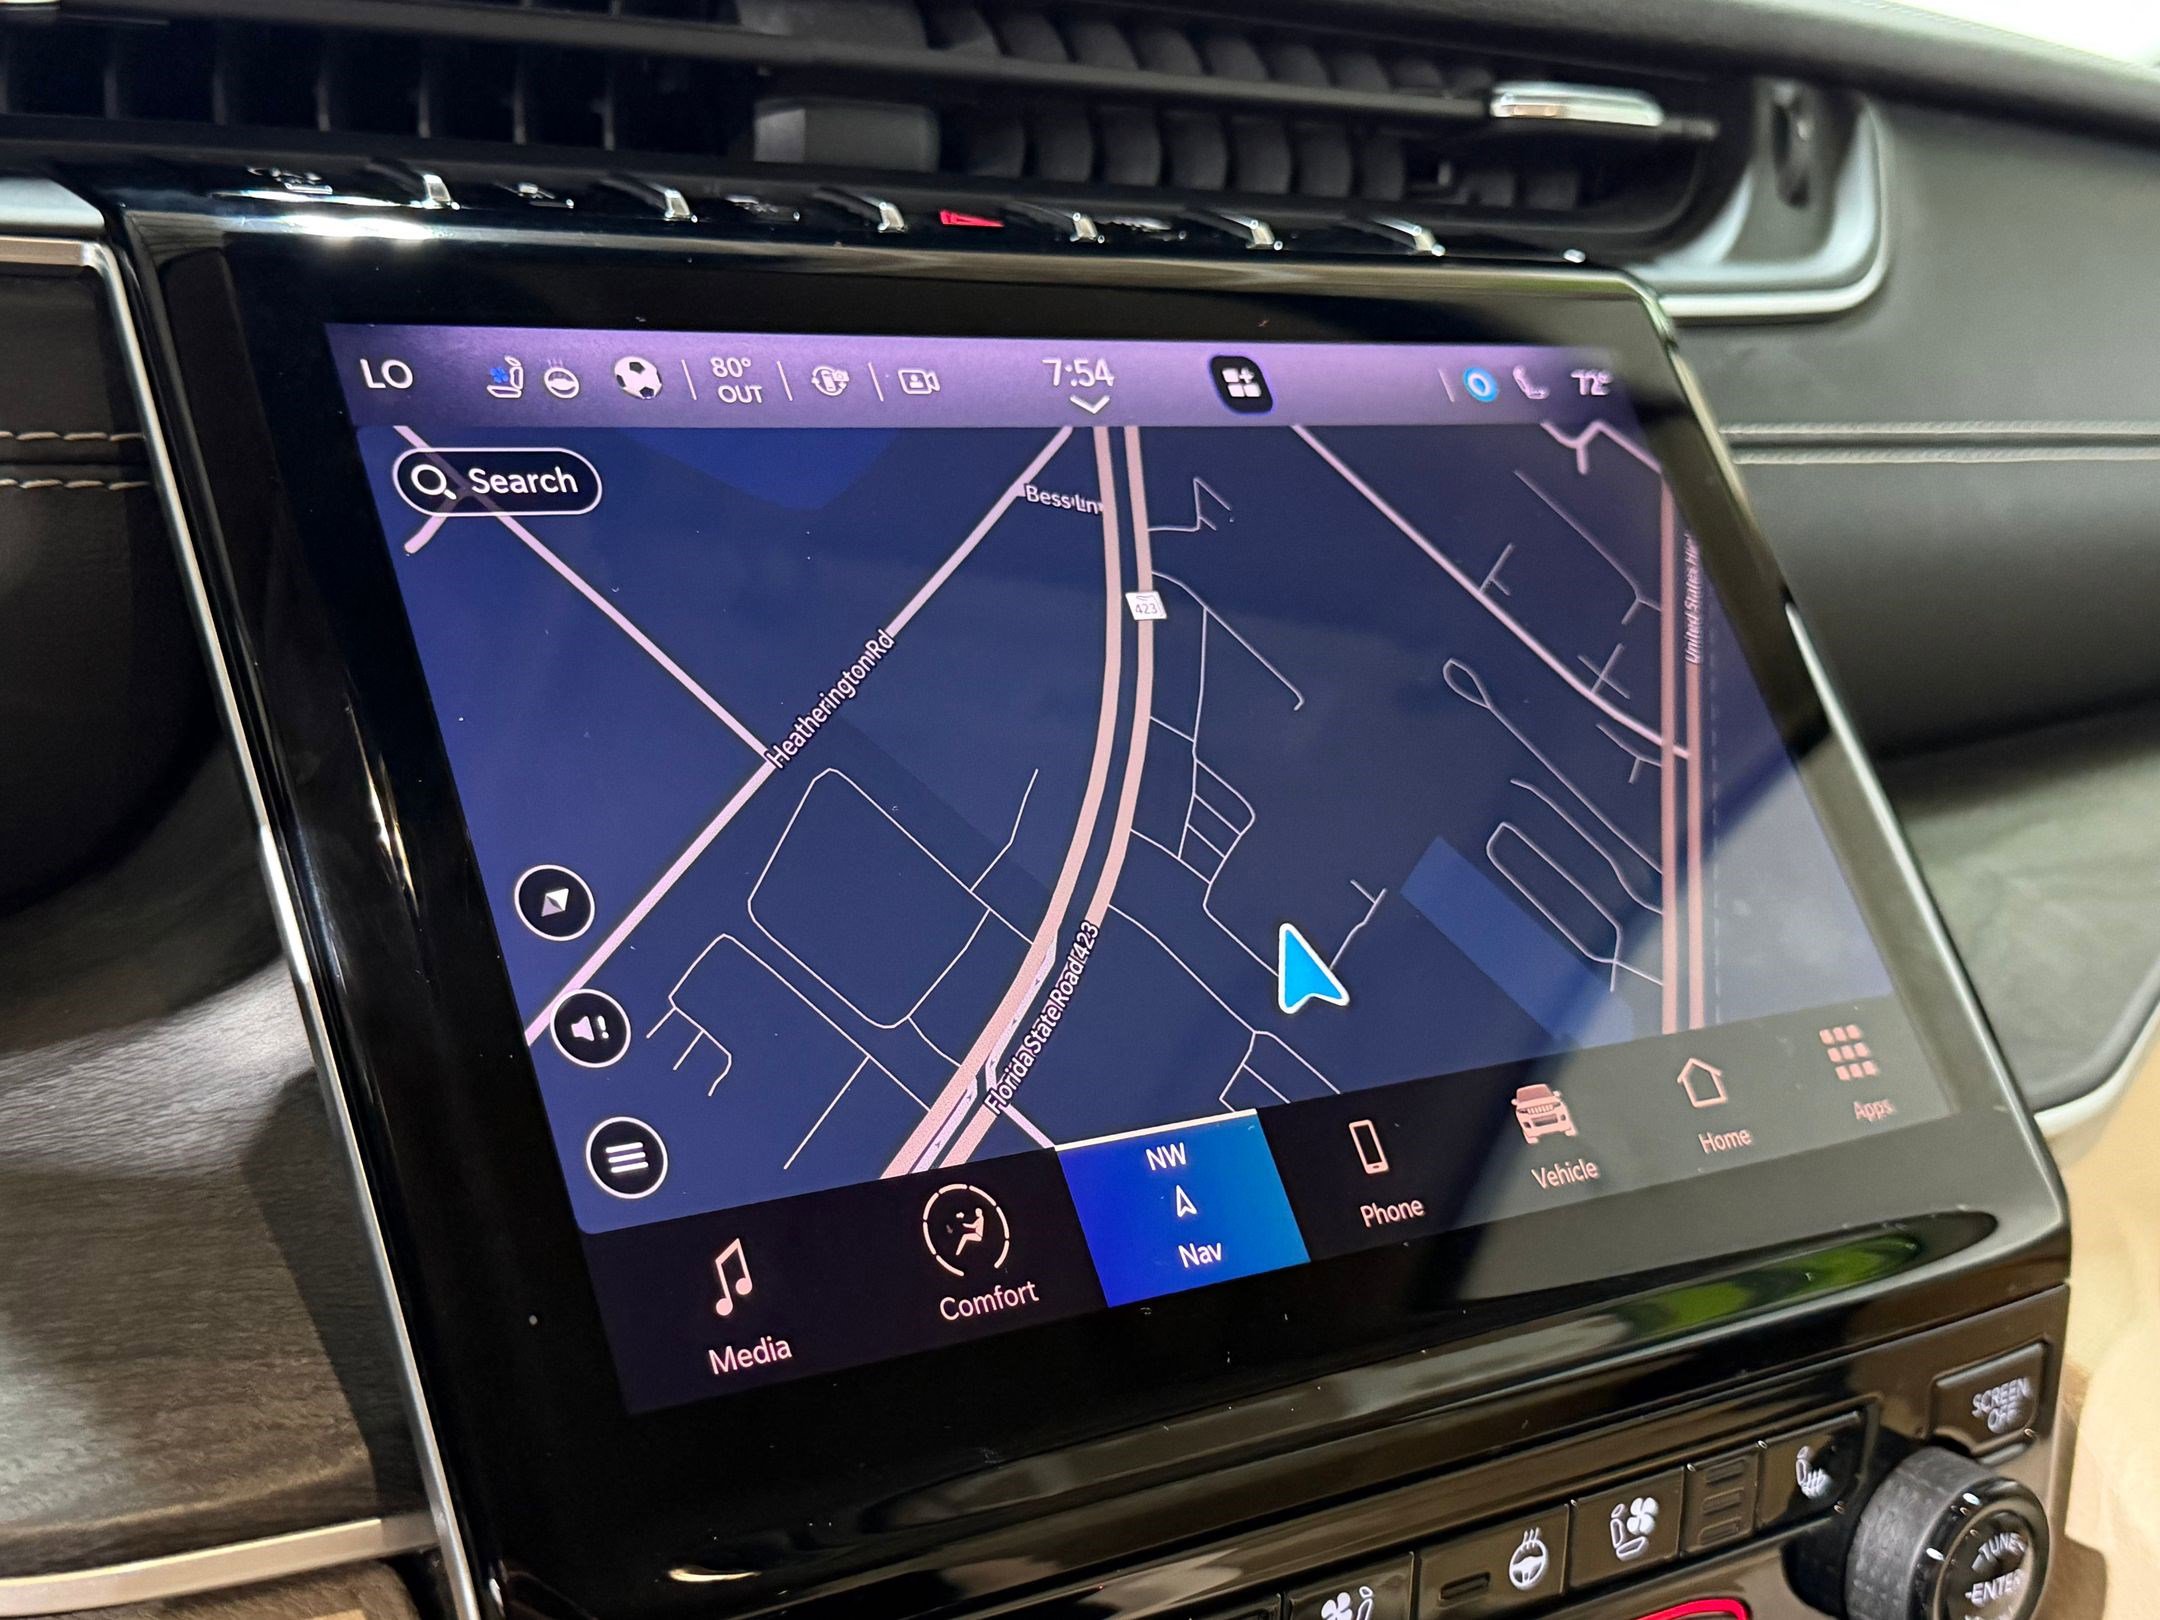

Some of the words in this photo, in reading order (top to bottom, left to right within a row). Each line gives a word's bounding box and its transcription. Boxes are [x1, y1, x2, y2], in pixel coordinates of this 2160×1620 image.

[360, 358, 413, 391] LO
[710, 357, 752, 379] 80°
[1042, 358, 1114, 387] 7:54
[717, 383, 763, 405] OUT
[467, 466, 580, 496] Search
[1025, 484, 1071, 509] Bess
[1135, 602, 1159, 615] 423
[1684, 611, 1702, 664] United
[766, 653, 876, 769] Heatherington
[864, 628, 895, 660] Rd
[984, 1054, 1035, 1115] Florida
[1024, 1006, 1061, 1055] State
[1049, 957, 1084, 1009] Road
[1073, 921, 1099, 962] 423
[1853, 1098, 1896, 1123] Apps
[1700, 1126, 1753, 1155] Home
[1145, 1142, 1188, 1172] NW
[1530, 1158, 1600, 1191] Vehicle
[1360, 1197, 1425, 1229] Phone
[1178, 1239, 1223, 1269] Nav
[939, 1279, 1040, 1322] Comfort
[708, 1336, 793, 1376] Media
[1972, 1376, 2031, 1418] SCREEN
[1987, 1402, 2020, 1433] OFF
